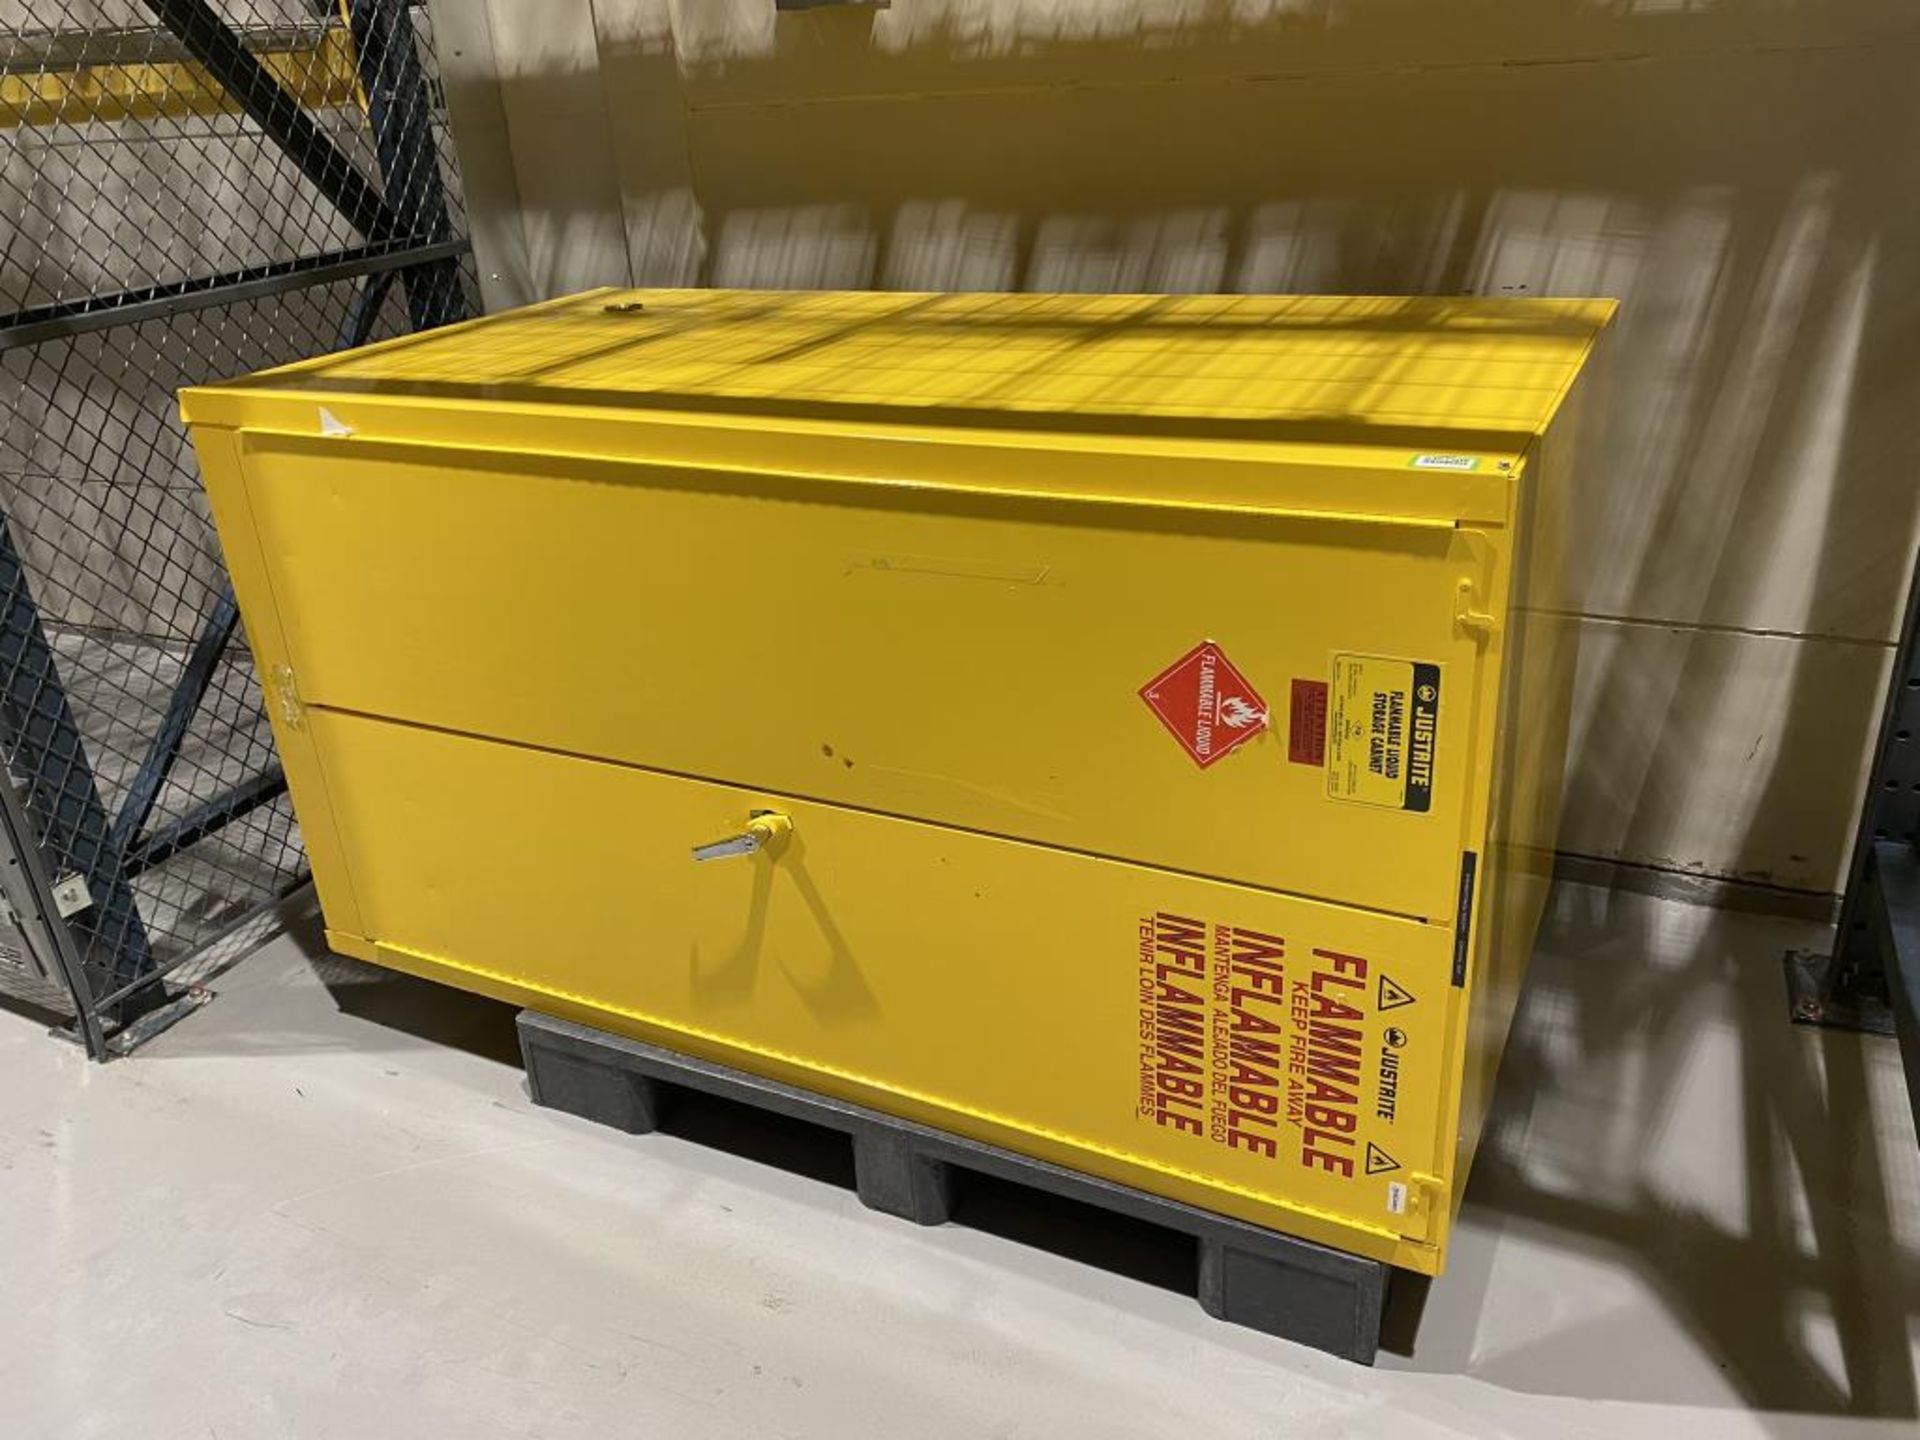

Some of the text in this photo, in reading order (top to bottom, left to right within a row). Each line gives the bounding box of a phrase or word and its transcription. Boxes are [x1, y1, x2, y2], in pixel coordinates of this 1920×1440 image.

[1195, 653, 1216, 755] FLAMMABLE LIQUID
[1368, 691, 1387, 775] STORAGE CABINET
[1385, 690, 1404, 779] FLAMMABLE LIQUID
[1411, 706, 1434, 787] JUSTRITE
[1139, 916, 1157, 1117] TENIR LOIN DES FLAMMES
[1156, 912, 1206, 1136] INFLAMMABLE
[1211, 924, 1230, 1144] MANTENGA ALEJADO DEL FUEGO
[1228, 927, 1285, 1159] INFLAMABLE
[1286, 980, 1309, 1128] KEEP FIRE AWAY
[1302, 948, 1368, 1178] FLAMMABLE
[1377, 1047, 1400, 1120] JUSTRITE
